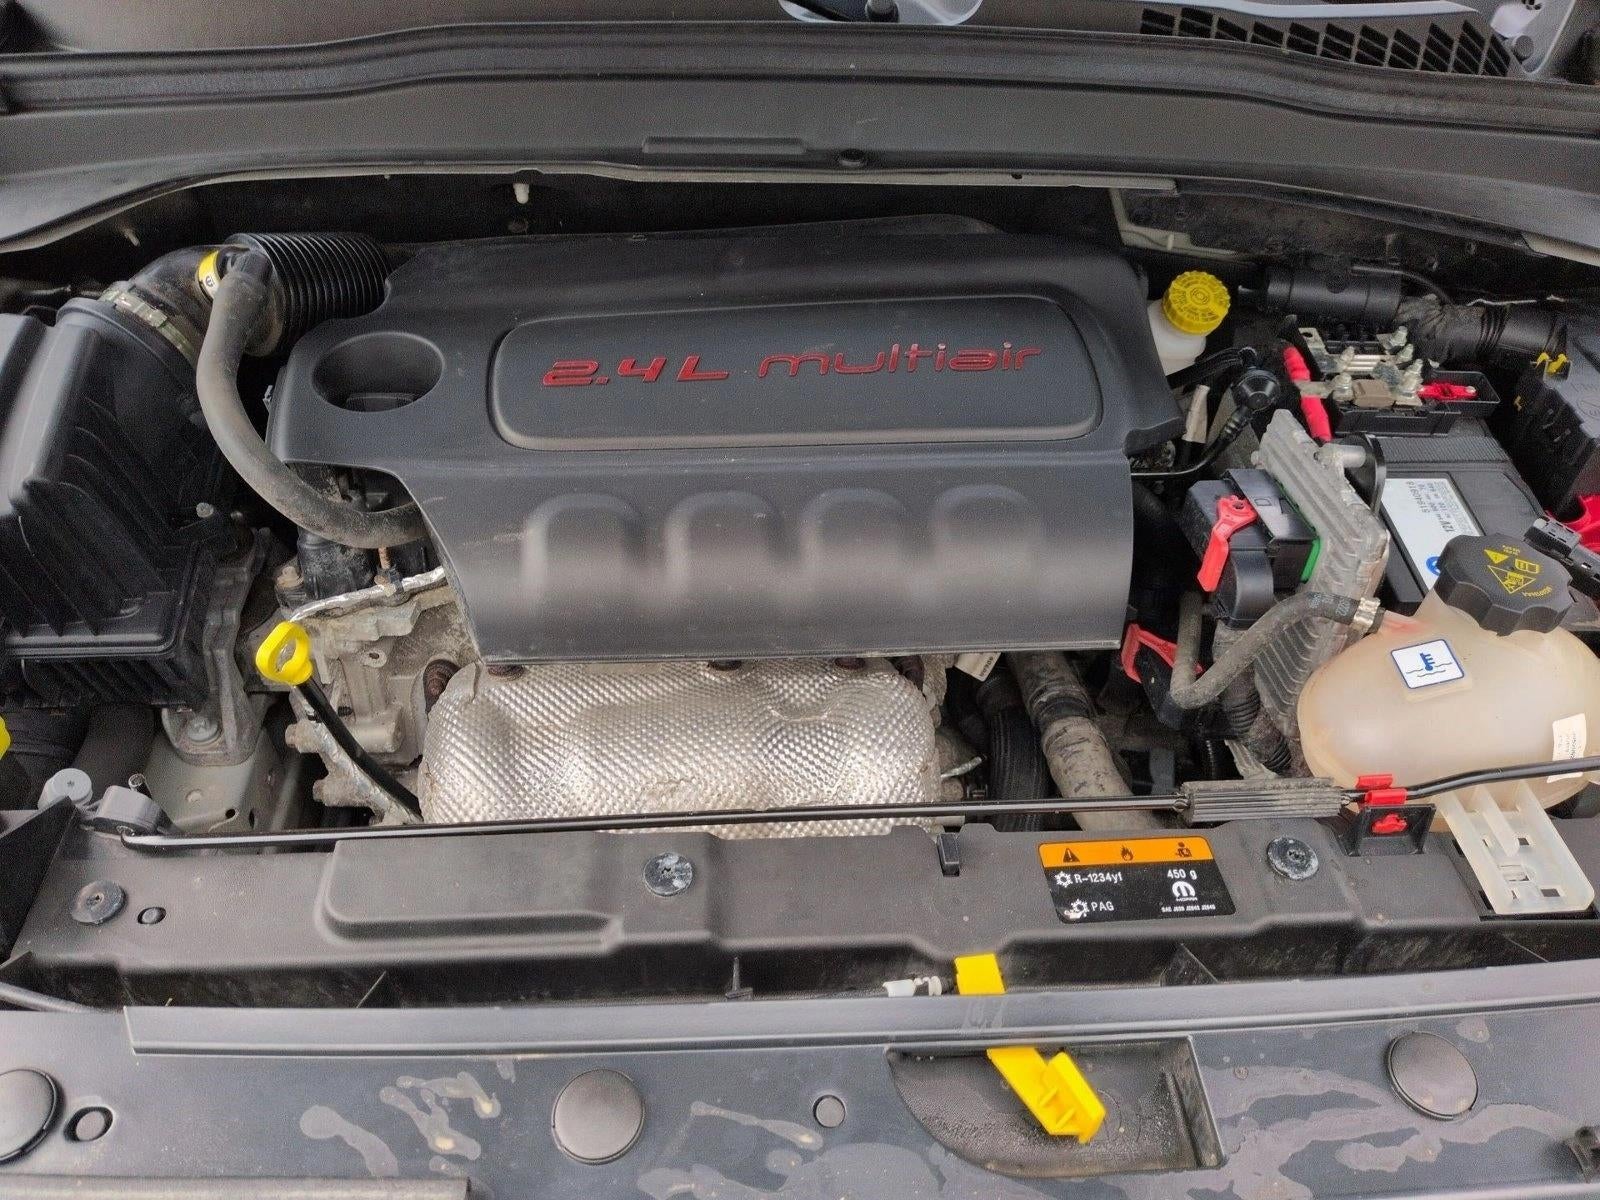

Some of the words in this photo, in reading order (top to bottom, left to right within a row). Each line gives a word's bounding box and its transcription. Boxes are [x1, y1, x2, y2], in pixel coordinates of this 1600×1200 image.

[758, 341, 1043, 378] multiair
[1074, 871, 1123, 884] R-1234yf
[1166, 868, 1186, 880] 450
[1189, 870, 1198, 881] g
[1090, 900, 1115, 912] PAG
